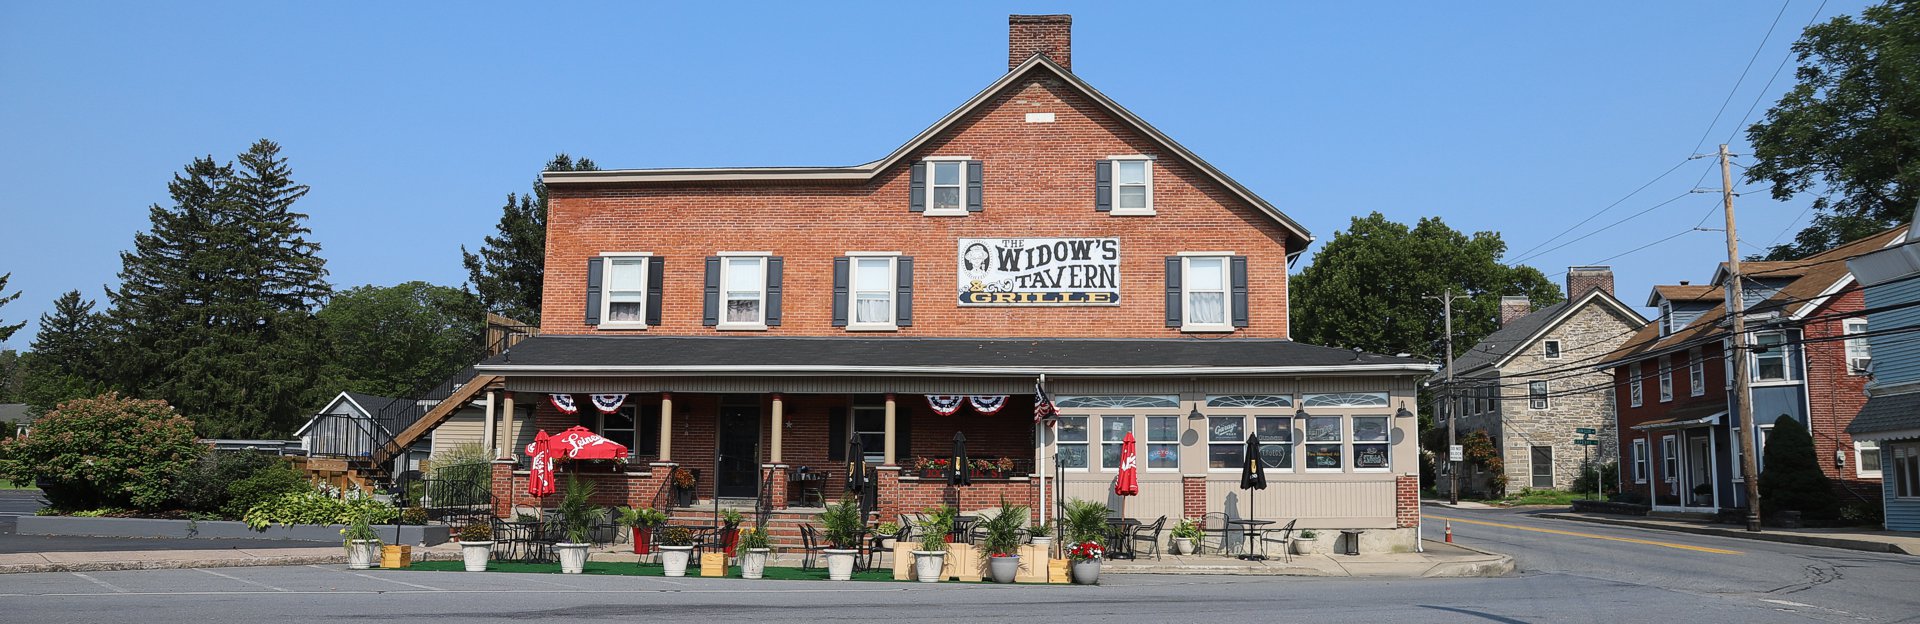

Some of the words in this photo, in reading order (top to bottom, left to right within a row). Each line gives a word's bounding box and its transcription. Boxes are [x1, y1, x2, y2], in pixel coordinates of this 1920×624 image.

[1002, 239, 1024, 248] THE
[995, 240, 1117, 272] WIDOW'S
[1015, 264, 1117, 288] TAVERN
[969, 279, 987, 292] &
[970, 292, 1111, 303] GRILLE
